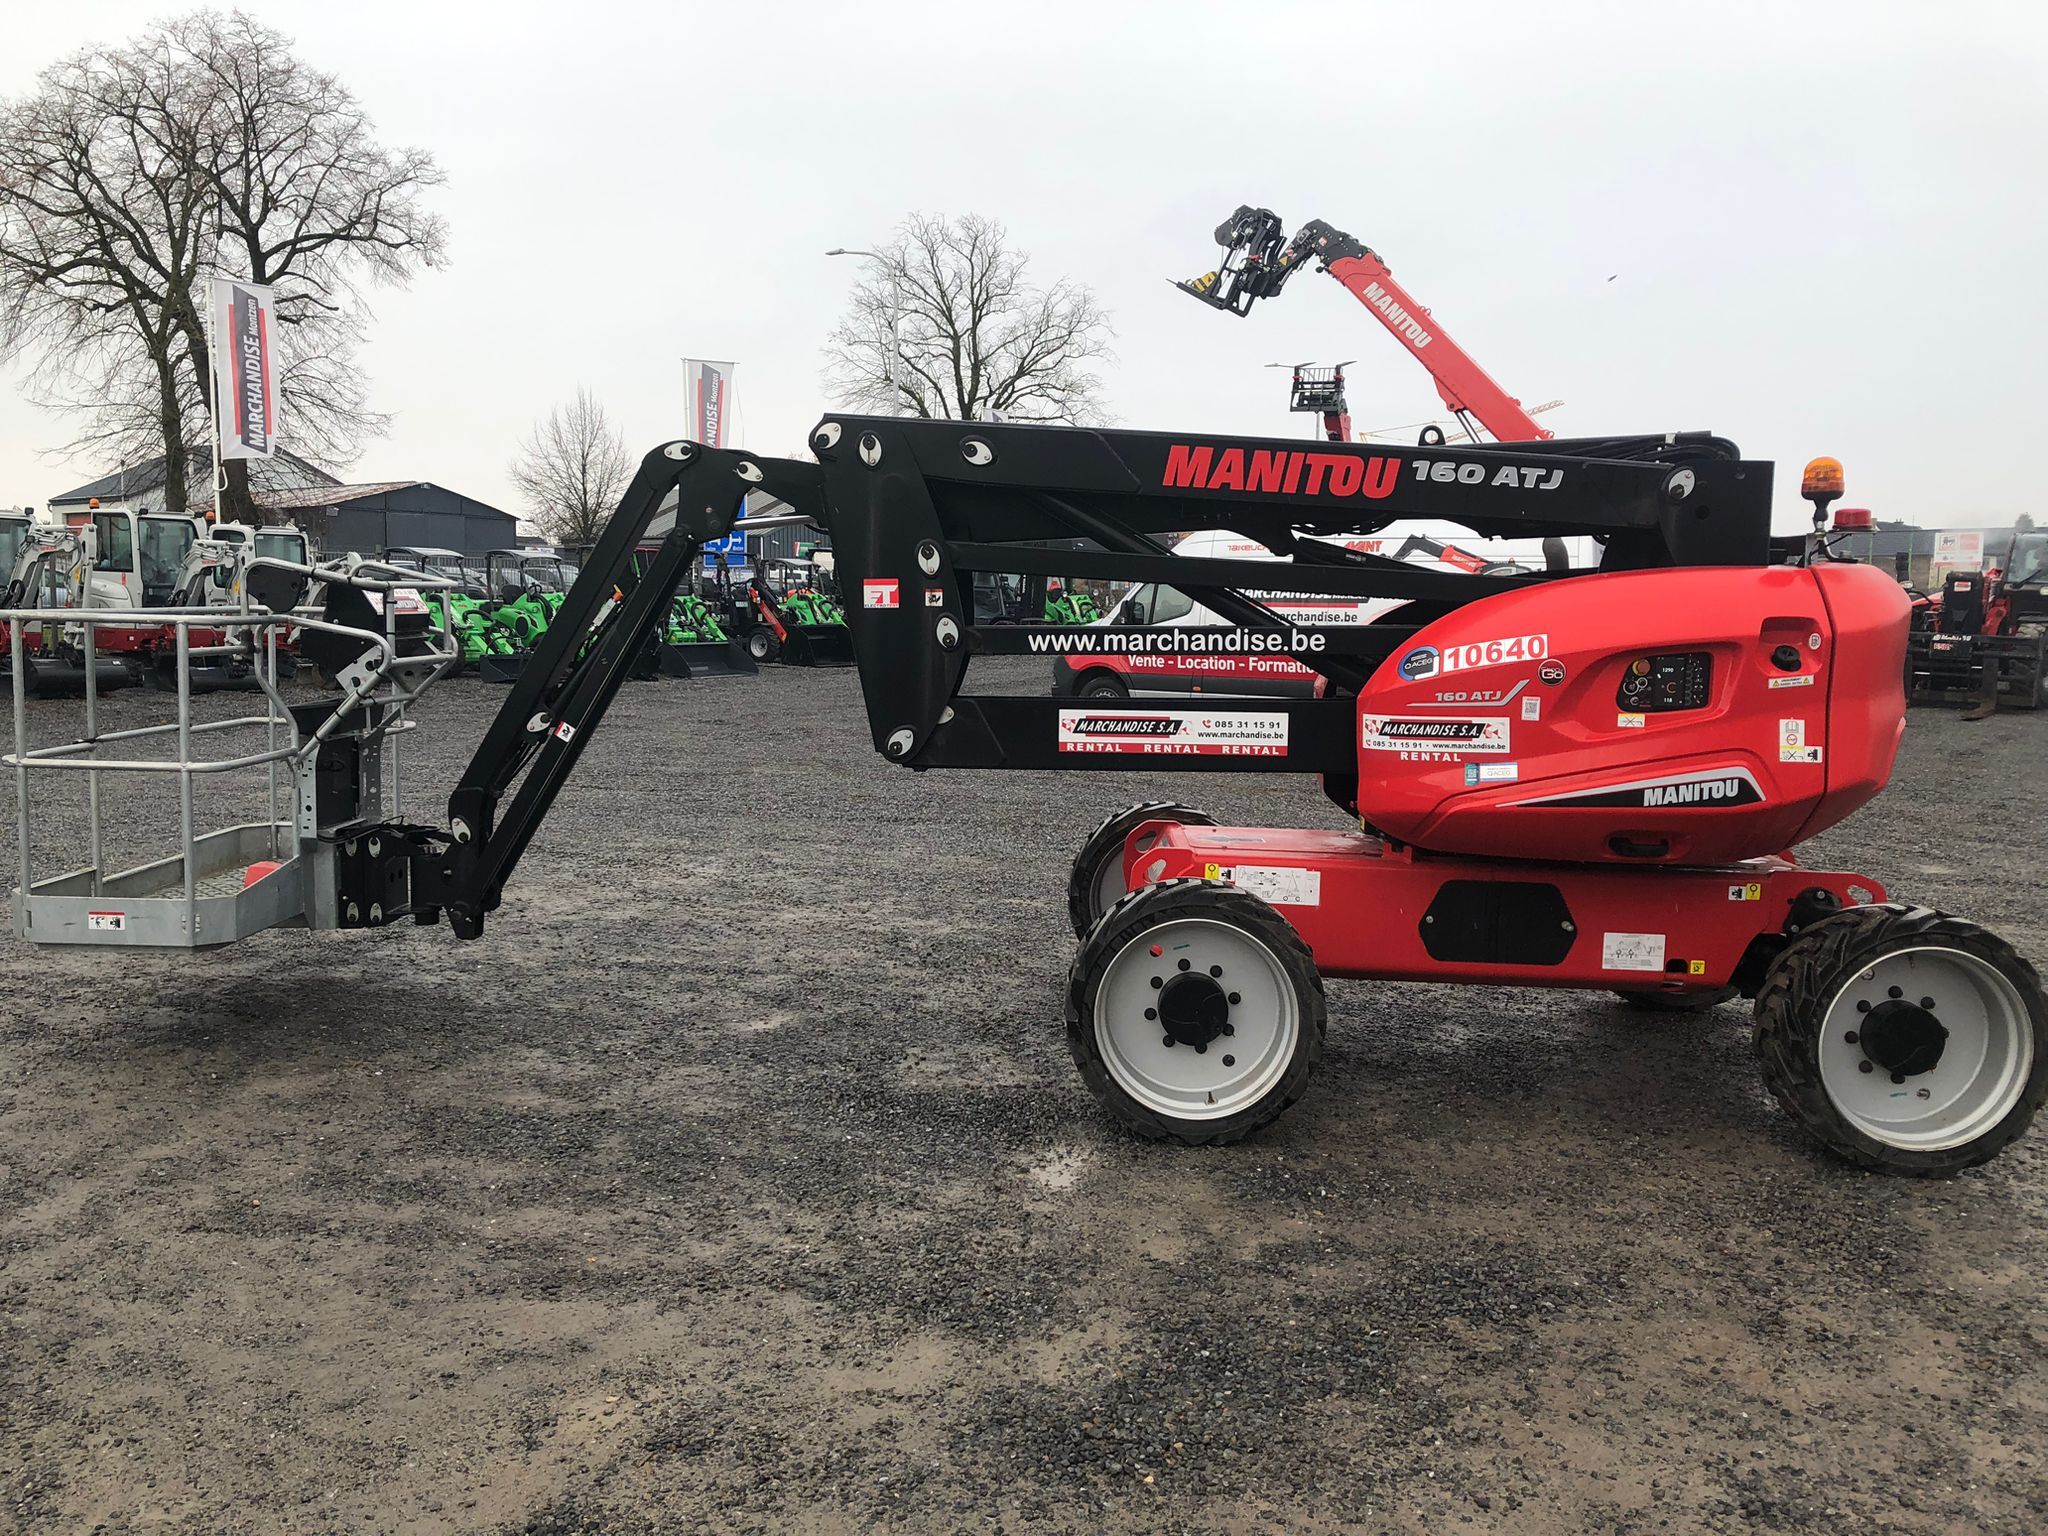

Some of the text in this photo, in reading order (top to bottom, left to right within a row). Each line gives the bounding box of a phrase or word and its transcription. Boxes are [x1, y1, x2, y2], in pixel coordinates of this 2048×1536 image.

[1362, 281, 1433, 348] MANITOU
[243, 298, 265, 447] MARCHANDISE Montzen
[706, 373, 720, 447] ANDISE Montzen
[1162, 444, 1564, 499] MANITOU 160 ATJ
[1028, 628, 1326, 652] www.marchandise.be
[1448, 636, 1545, 669] 10640
[1128, 655, 1165, 668] Vente
[1177, 655, 1235, 671] Location
[1435, 690, 1502, 701] 160 ATJ
[1077, 720, 1177, 733] MARCHANDISE S.A.
[1215, 720, 1233, 728] 085
[1254, 721, 1265, 729] 15
[1268, 721, 1280, 729] 91
[1382, 723, 1479, 736] MARCHANDISE S.A.
[1198, 731, 1284, 739] www.marchandise.be
[1067, 743, 1280, 755] RENTAL RENTAL RENTAL
[1373, 740, 1386, 748] 085
[1433, 742, 1506, 750] www.marchandise.be
[1400, 751, 1461, 762] RENTAL
[1643, 778, 1739, 807] MANITOU
